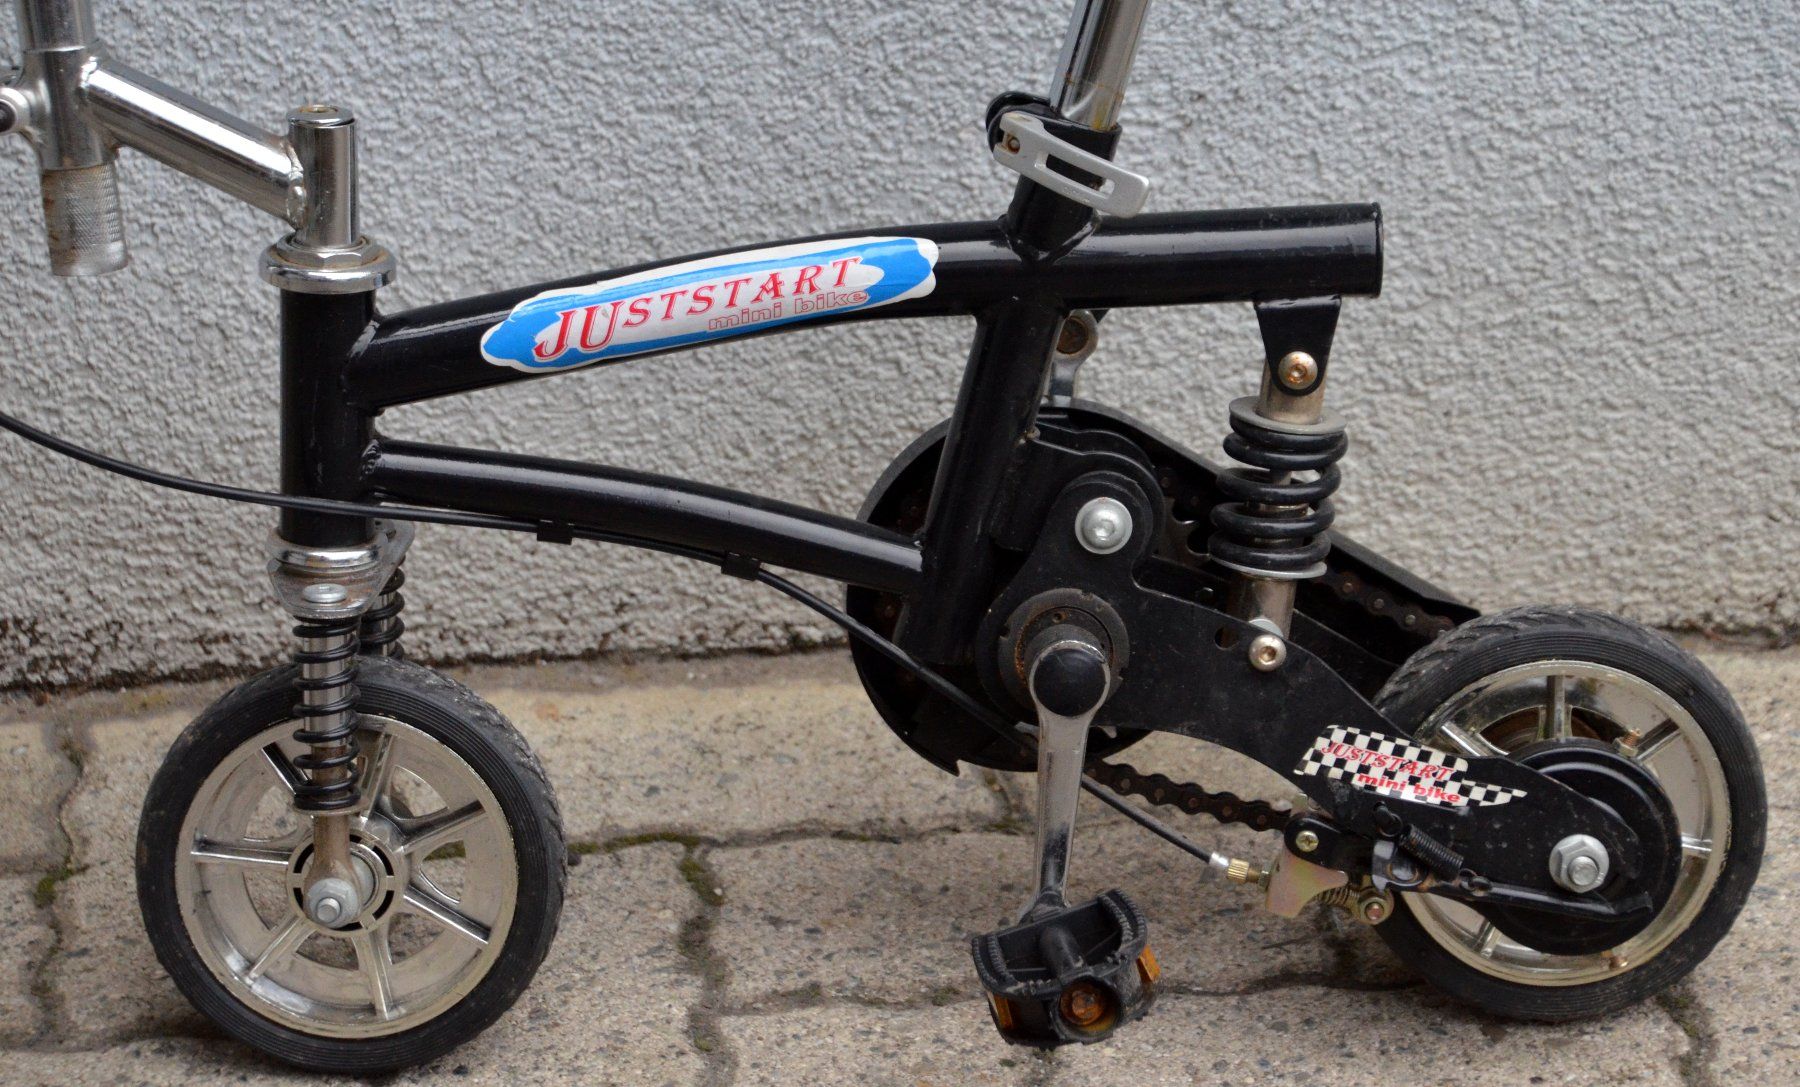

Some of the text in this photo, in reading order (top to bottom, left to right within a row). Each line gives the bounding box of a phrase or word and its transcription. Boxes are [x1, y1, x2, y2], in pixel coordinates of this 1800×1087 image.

[533, 257, 861, 359] JUSTSTART
[708, 290, 868, 330] mini bike
[1322, 741, 1455, 781] JUSTSTART
[1357, 773, 1461, 802] mini bike
